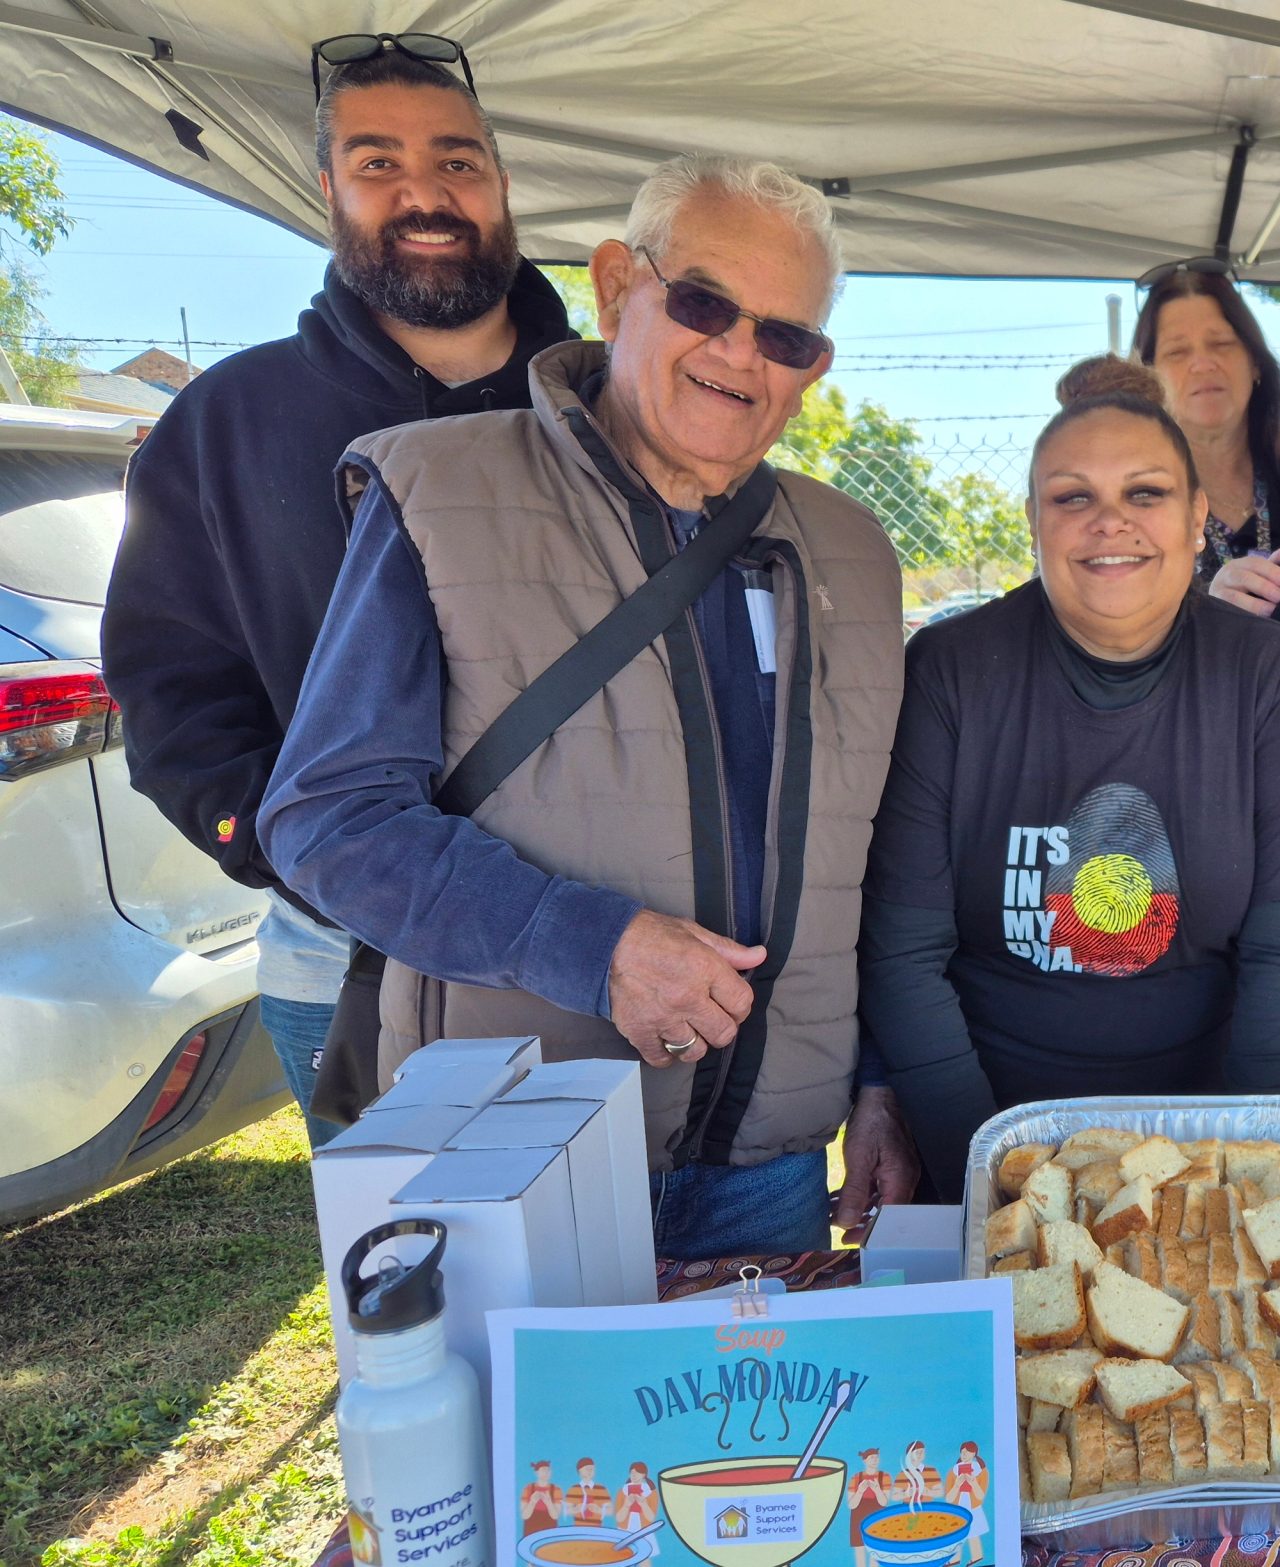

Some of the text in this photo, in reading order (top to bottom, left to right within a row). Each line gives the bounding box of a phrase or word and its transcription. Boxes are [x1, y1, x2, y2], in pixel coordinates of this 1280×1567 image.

[1007, 826, 1070, 866] IT'S
[1004, 869, 1042, 907] IN
[186, 912, 261, 944] KLUGER
[1003, 909, 1057, 944] MY
[715, 1323, 787, 1356] Soup
[633, 1360, 870, 1426] DAY MONDAY
[391, 1483, 473, 1523] Byamee
[755, 1504, 797, 1513] Byamee
[755, 1514, 795, 1524] Support
[394, 1503, 473, 1543] Support
[756, 1526, 798, 1535] Services
[397, 1523, 479, 1563] Services
